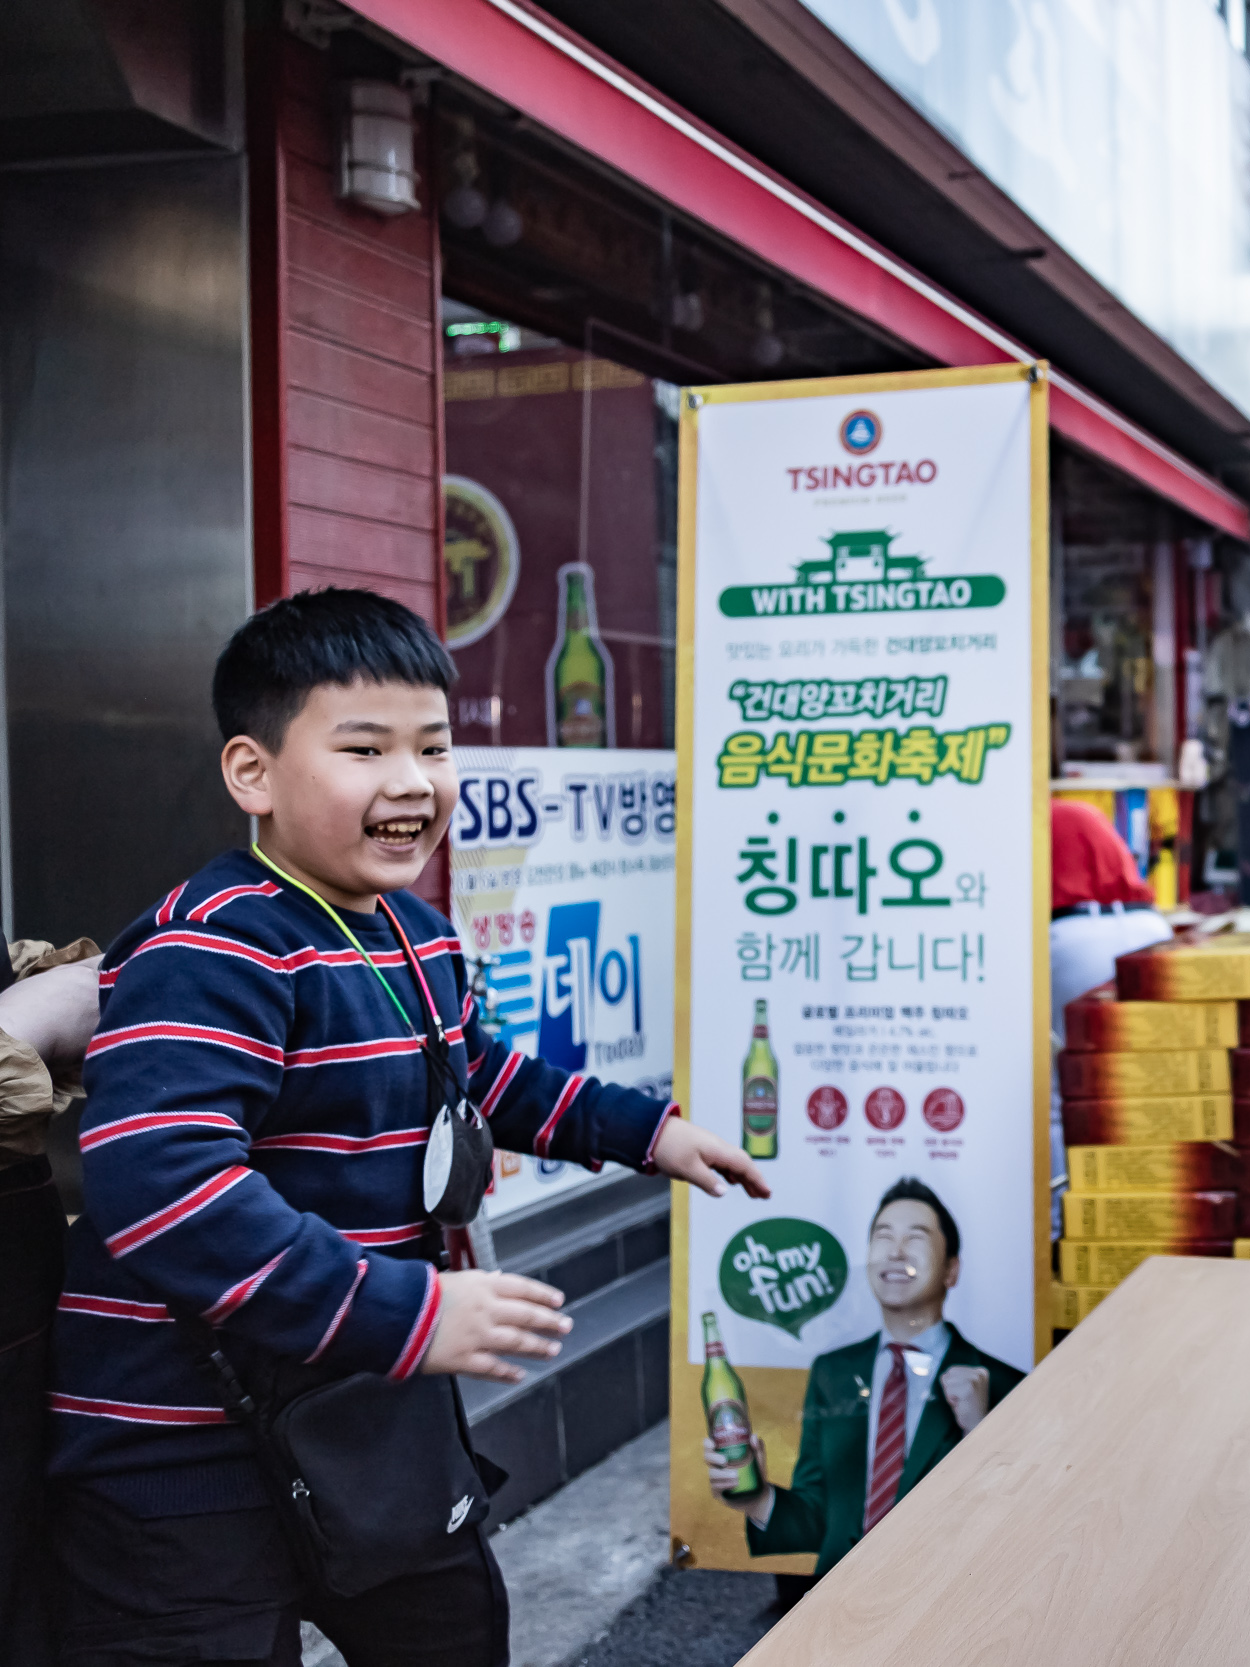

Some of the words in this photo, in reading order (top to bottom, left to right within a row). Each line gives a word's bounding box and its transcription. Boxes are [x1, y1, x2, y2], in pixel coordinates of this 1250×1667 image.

[786, 459, 938, 491] TSINGTAO
[752, 585, 825, 616] WITH
[831, 580, 972, 611] TSINGTAO
[725, 640, 772, 661] 맛있는
[779, 639, 825, 658] 요리가
[832, 636, 879, 656] 가득한
[719, 725, 1008, 786] 음식문화축제”
[472, 909, 537, 949] 생방송
[736, 931, 821, 981] 함께
[840, 932, 986, 982] 갑니다!
[733, 1236, 774, 1273] oh
[777, 1241, 821, 1272] my
[749, 1266, 833, 1313] fun!
